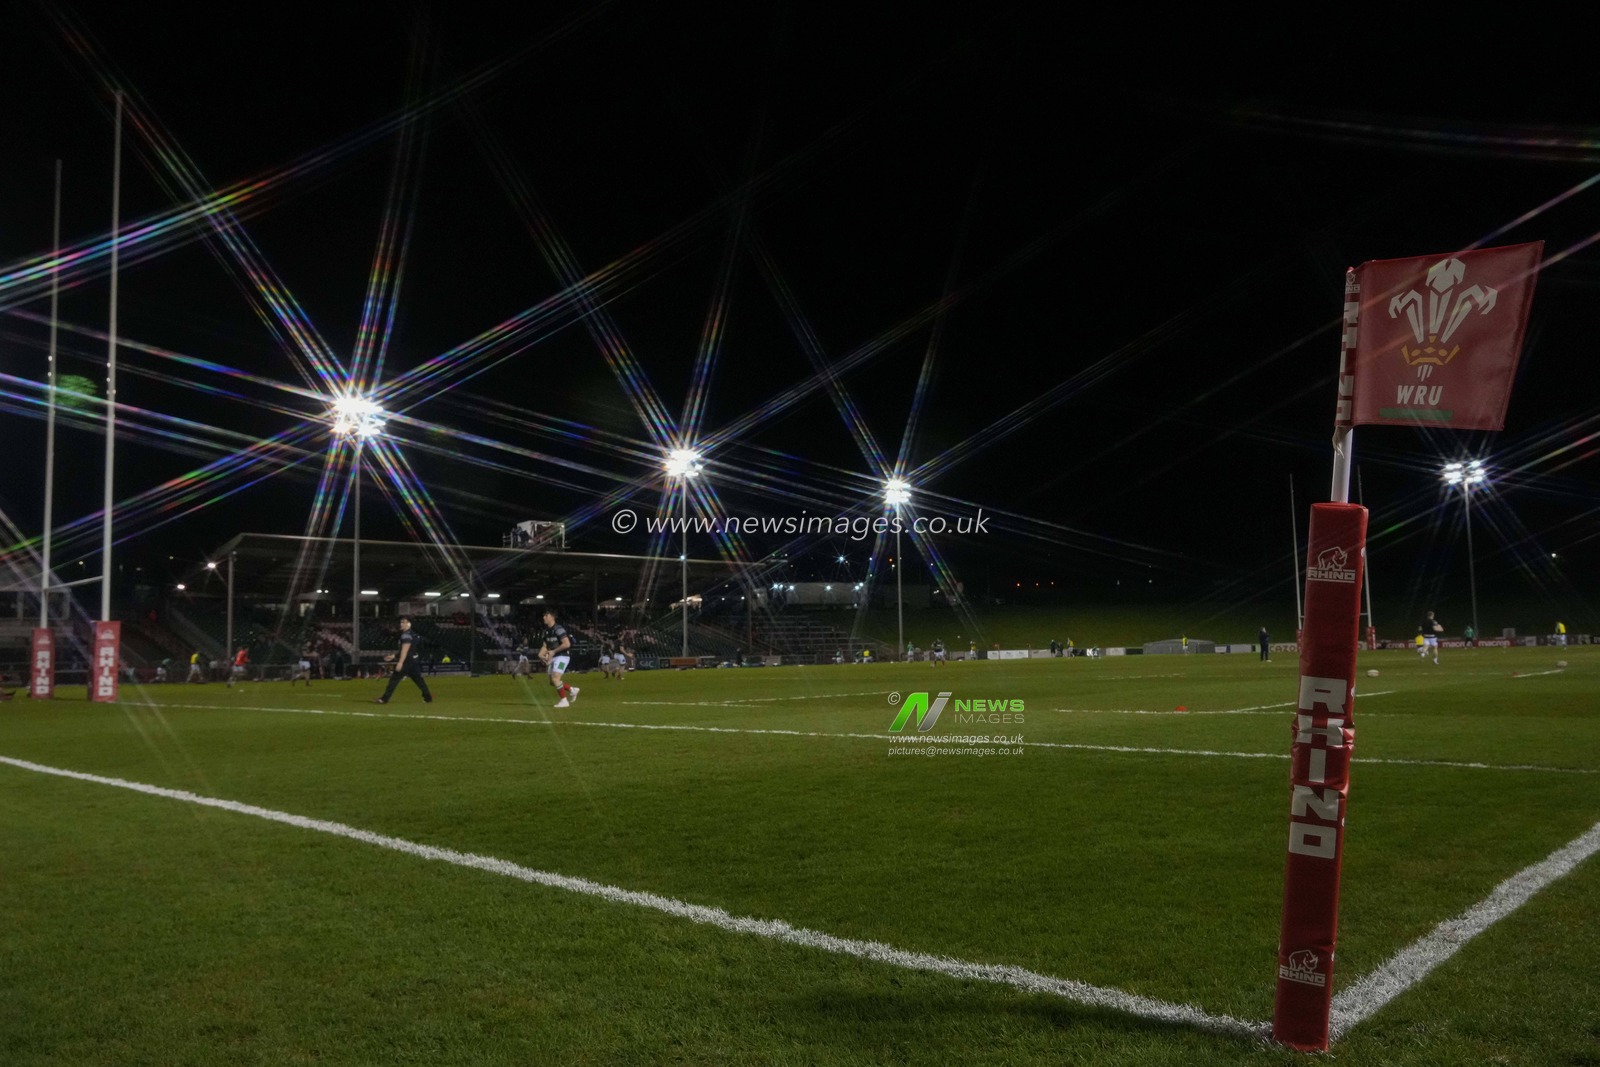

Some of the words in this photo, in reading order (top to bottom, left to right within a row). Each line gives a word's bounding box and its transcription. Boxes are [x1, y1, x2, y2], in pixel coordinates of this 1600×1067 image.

[1397, 385, 1443, 405] WRU
[1308, 569, 1355, 581] RHINO
[1289, 675, 1347, 859] RHINO
[1280, 967, 1325, 985] RHINO
